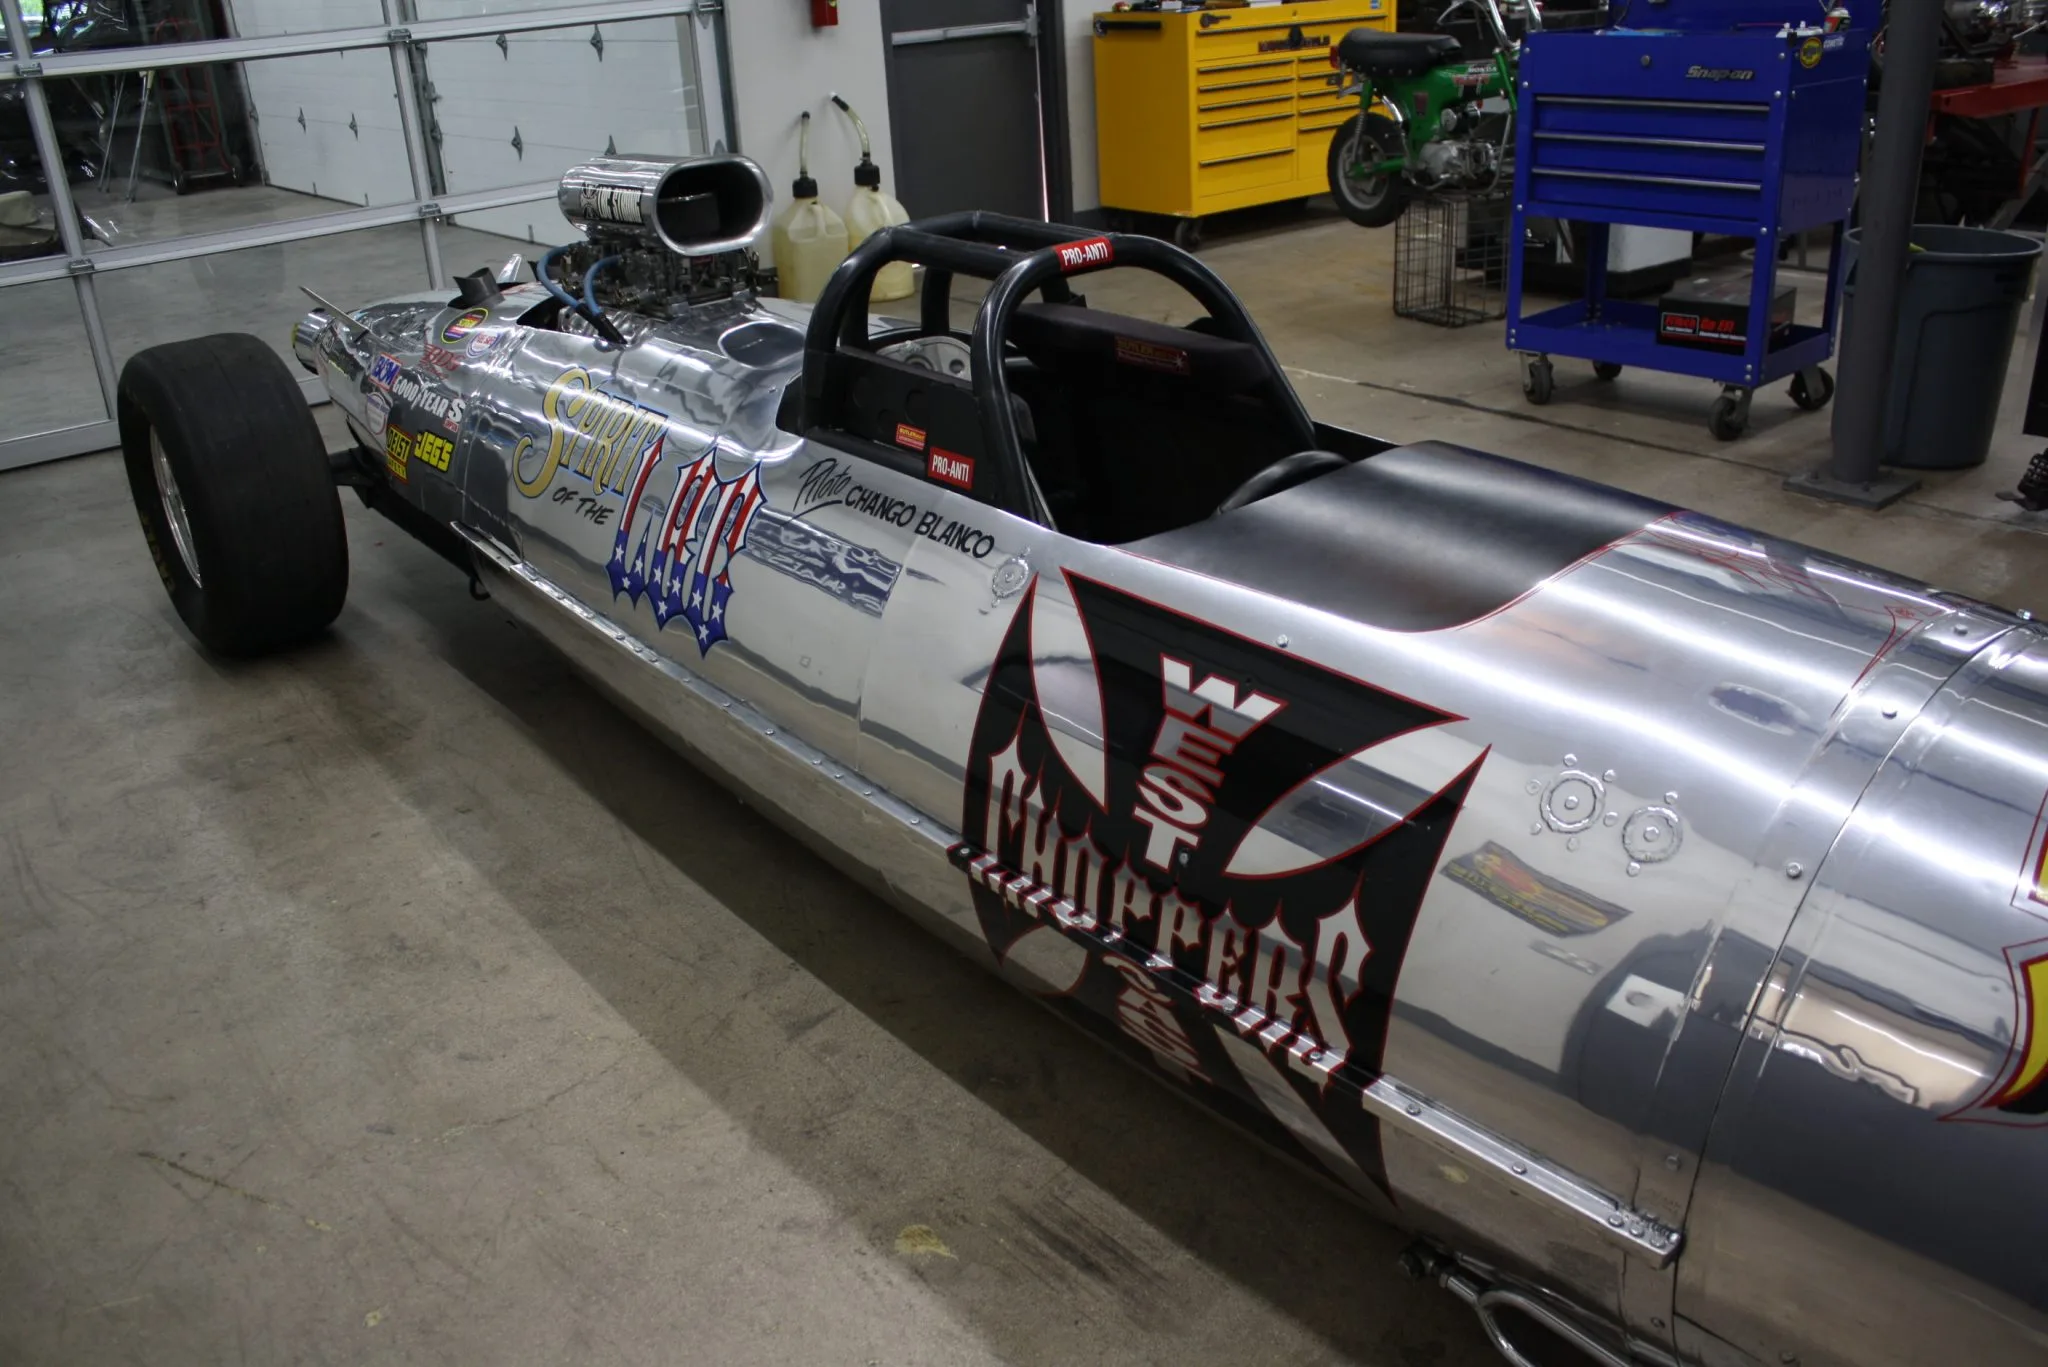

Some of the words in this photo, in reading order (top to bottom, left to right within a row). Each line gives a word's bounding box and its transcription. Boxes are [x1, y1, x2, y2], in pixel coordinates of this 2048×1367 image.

[1685, 65, 1754, 82] Snap-on
[1061, 242, 1109, 266] PRO-ANTI
[392, 375, 449, 418] GOODYEAR
[386, 427, 411, 462] DEIST
[931, 453, 969, 483] PRO-ANTI
[552, 486, 575, 505] OF
[578, 497, 615, 526] THE
[844, 484, 917, 528] CHANGO
[914, 511, 996, 559] BLANCO
[1132, 652, 1289, 871] WEST
[968, 700, 1376, 1096] CHOPPERS
